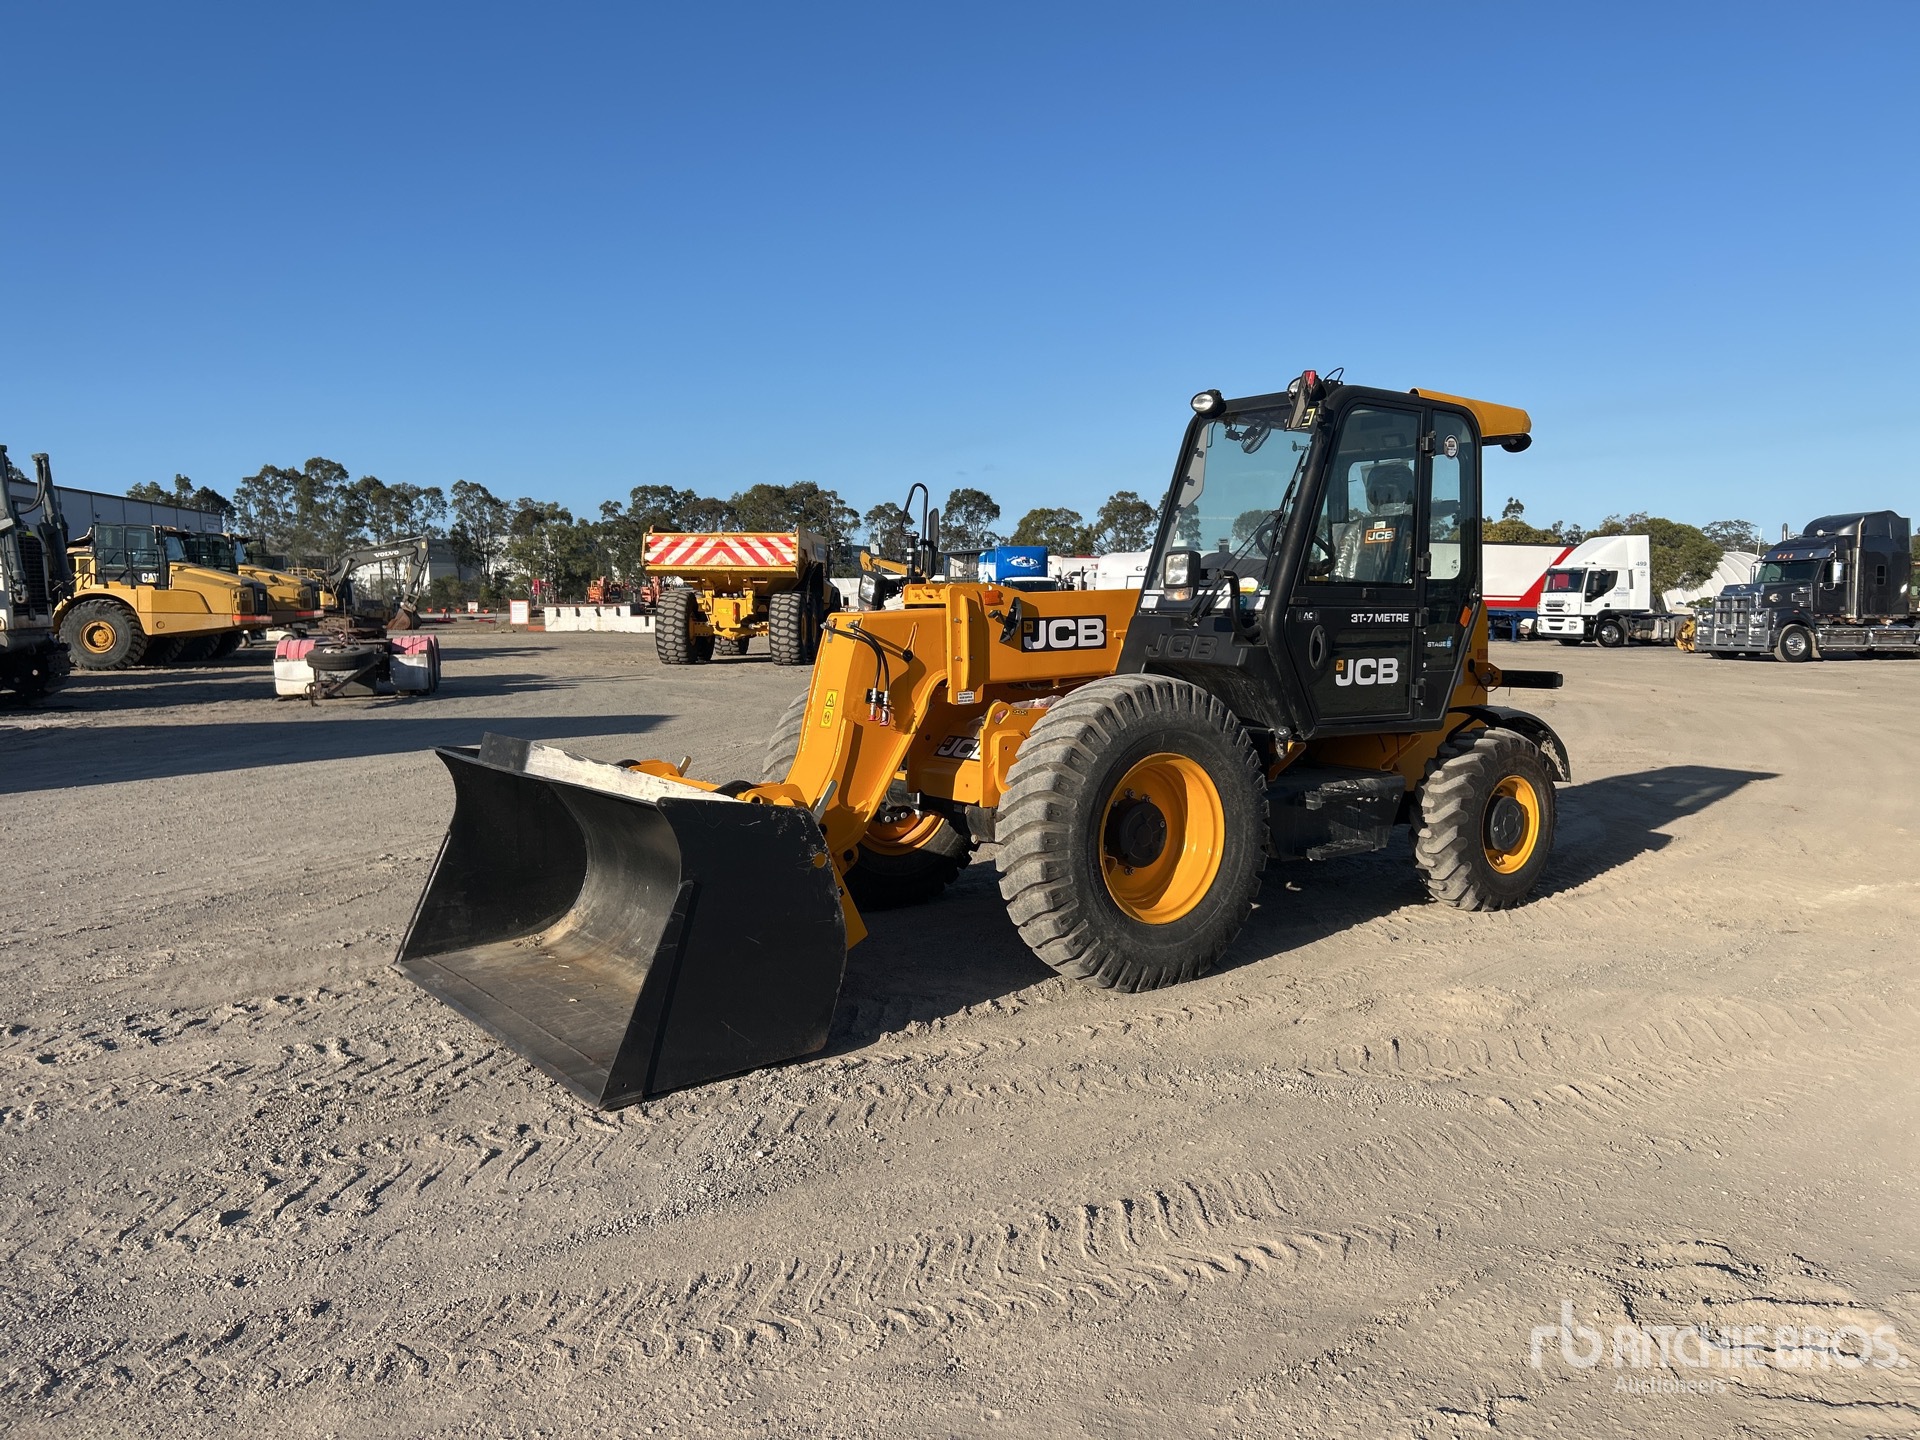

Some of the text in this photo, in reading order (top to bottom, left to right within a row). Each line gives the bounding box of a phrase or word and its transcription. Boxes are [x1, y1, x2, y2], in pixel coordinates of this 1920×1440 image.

[1367, 530, 1394, 541] JCB
[373, 550, 400, 558] VOLVO
[141, 572, 159, 583] CAT
[1303, 611, 1314, 619] AC
[1350, 612, 1410, 624] 3T-7 METRE
[1023, 617, 1105, 650] JCB
[1145, 632, 1218, 659] JCB
[1335, 657, 1399, 687] JCB
